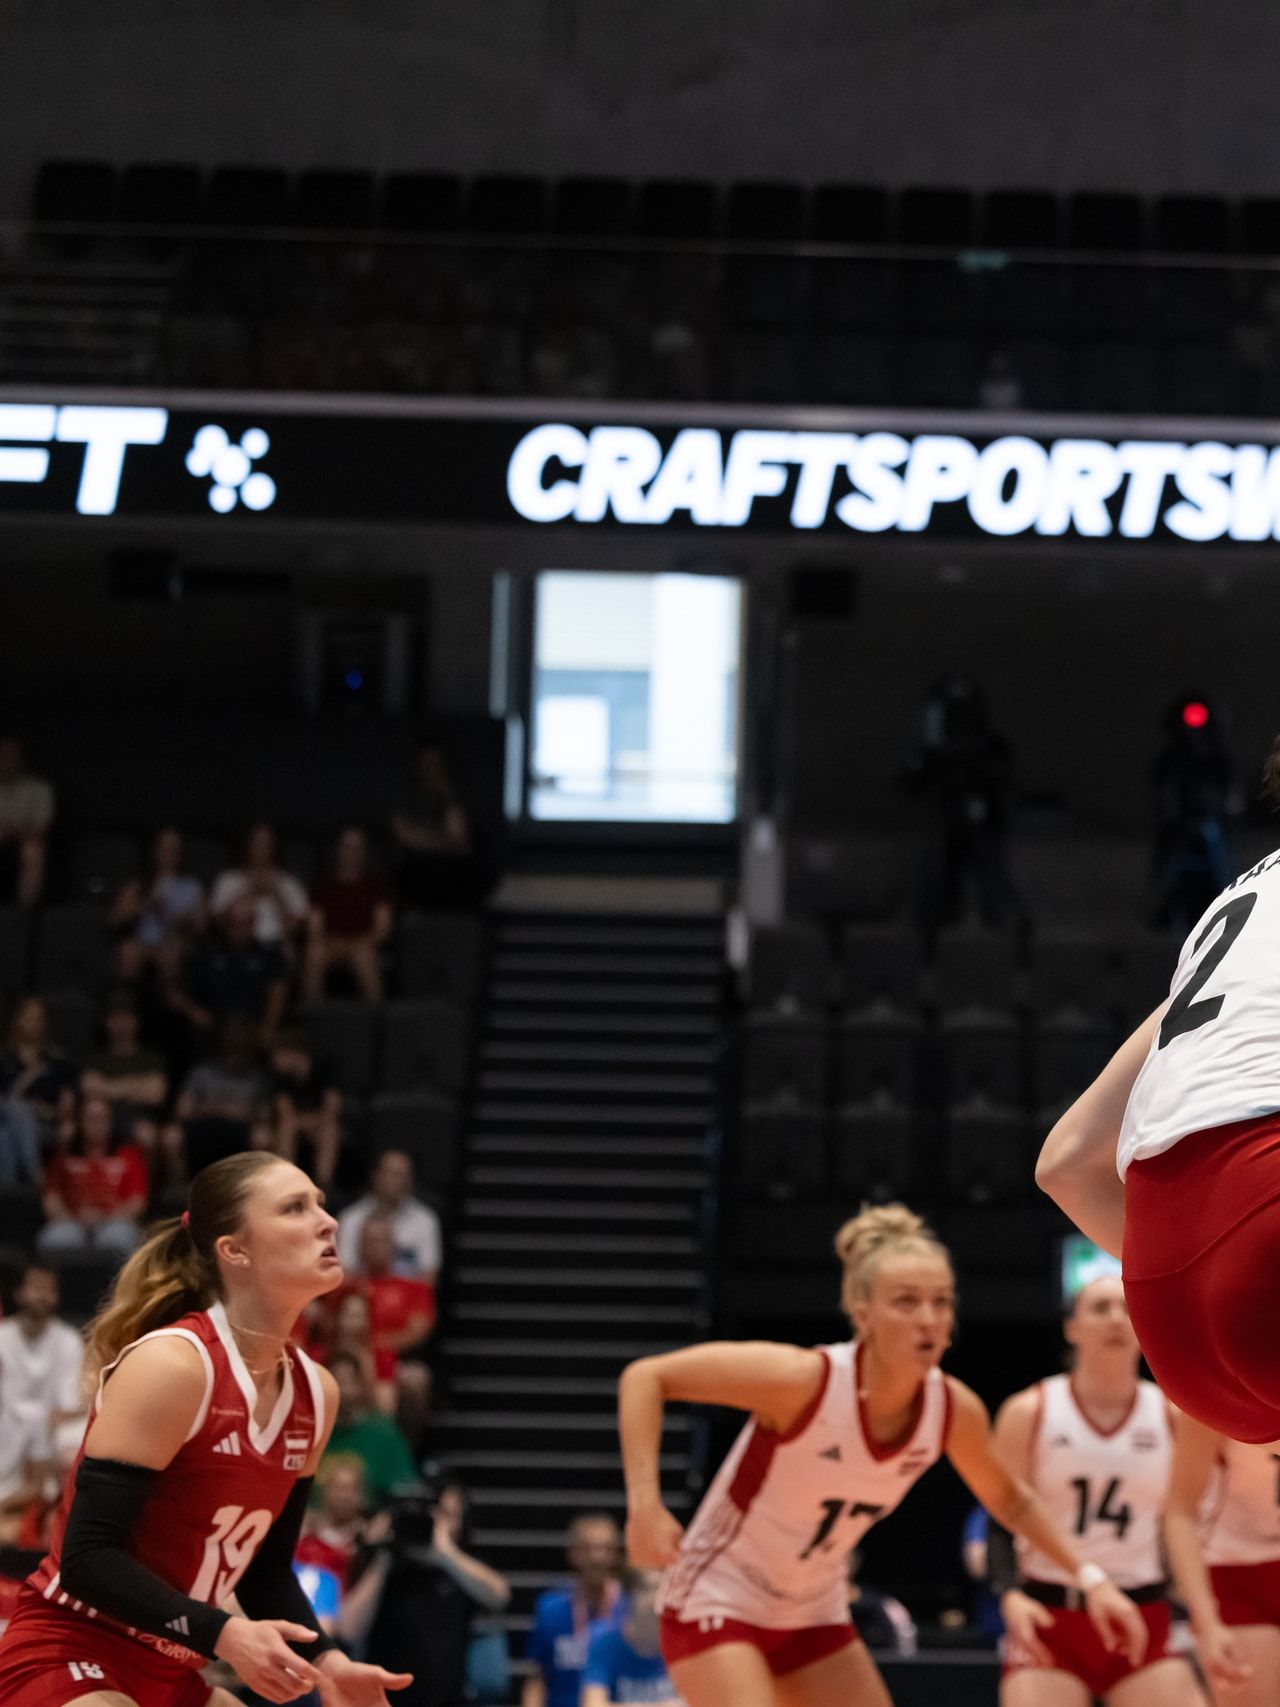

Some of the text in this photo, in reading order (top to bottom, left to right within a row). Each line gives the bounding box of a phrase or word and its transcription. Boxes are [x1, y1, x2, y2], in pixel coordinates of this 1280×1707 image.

[1157, 890, 1258, 1052] 2
[188, 1504, 273, 1610] 19
[1070, 1476, 1133, 1540] 14
